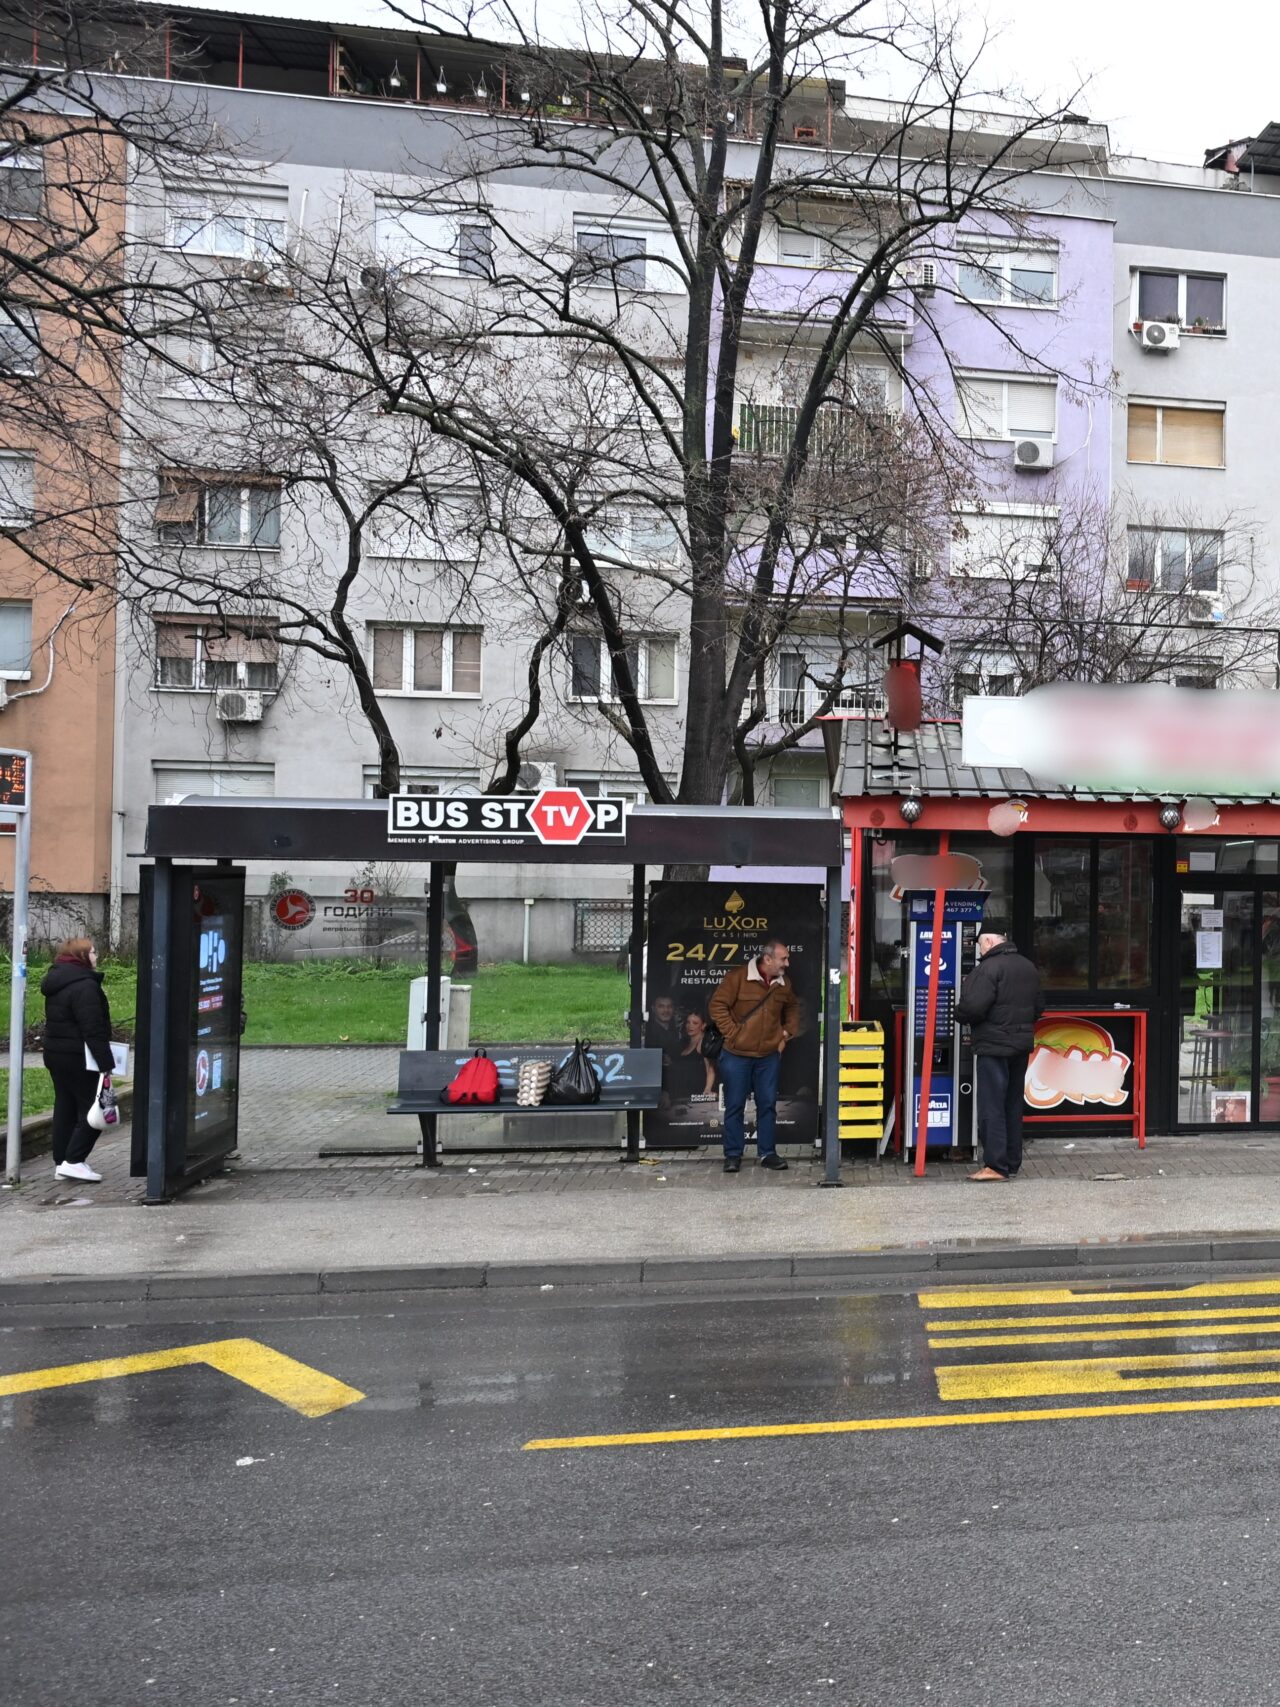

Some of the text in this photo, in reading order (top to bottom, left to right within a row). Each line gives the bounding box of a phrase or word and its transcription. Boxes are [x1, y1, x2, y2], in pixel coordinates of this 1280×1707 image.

[396, 801, 469, 829] BUS
[343, 889, 375, 904] 30
[703, 915, 769, 930] LUXOR
[919, 931, 953, 940] LAVZA
[665, 943, 739, 962] 24/7
[743, 944, 765, 952] LIVE
